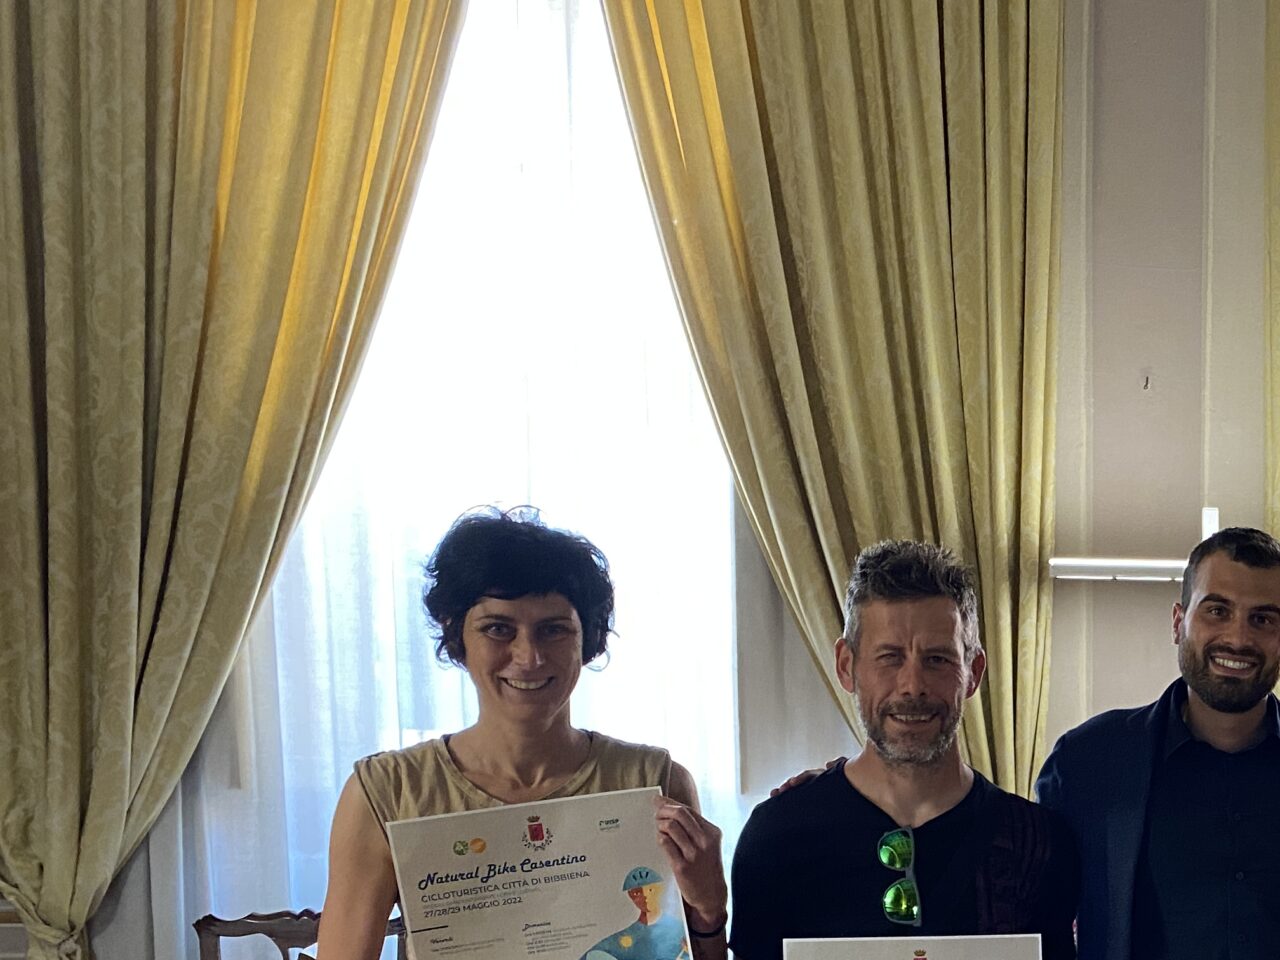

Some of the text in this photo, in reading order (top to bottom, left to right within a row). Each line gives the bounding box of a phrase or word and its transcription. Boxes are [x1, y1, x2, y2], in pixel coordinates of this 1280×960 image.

[418, 854, 587, 890] Natural Bike Casentino
[421, 884, 500, 903] CICLOTURISTICA
[531, 878, 542, 886] DI
[544, 870, 590, 884] BIBBIENA
[424, 906, 461, 918] 27/28/29
[463, 900, 500, 912] MAGGIO
[502, 896, 523, 906] 2022
